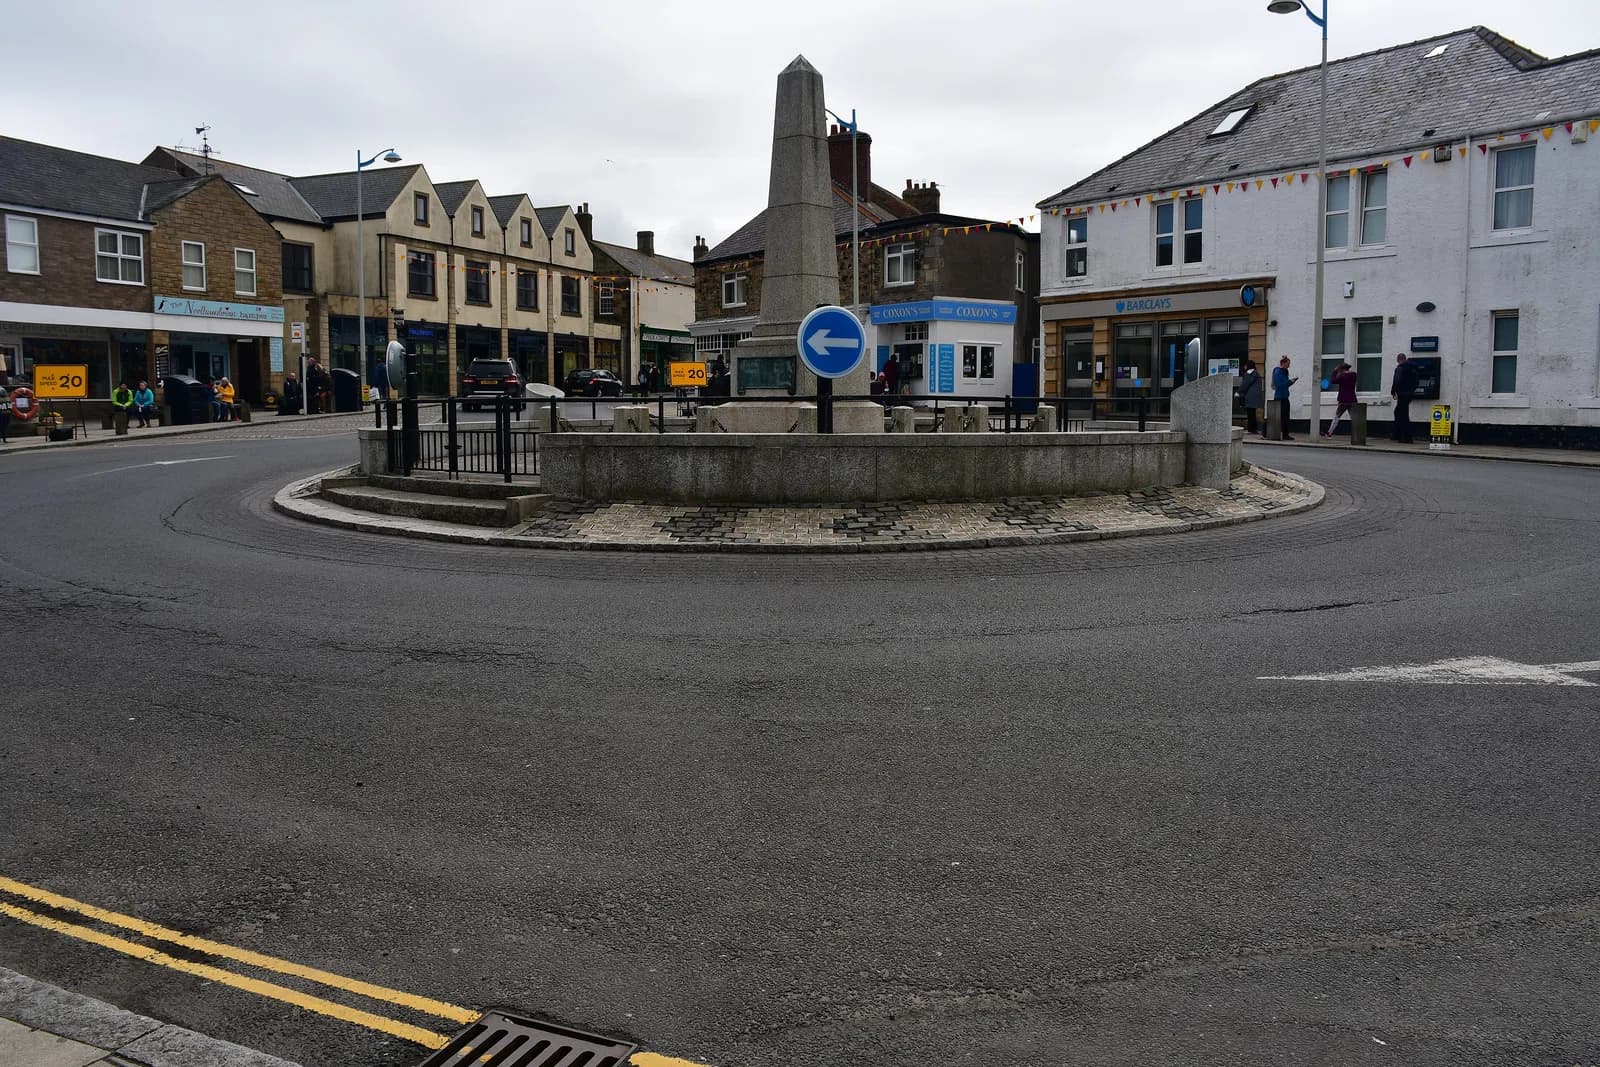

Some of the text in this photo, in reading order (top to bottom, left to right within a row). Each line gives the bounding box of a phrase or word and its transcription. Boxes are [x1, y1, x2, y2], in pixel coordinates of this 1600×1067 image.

[1127, 298, 1172, 311] BARCLAYS
[883, 306, 918, 318] COXON'S
[956, 306, 999, 319] COXON'S
[688, 369, 704, 379] 20
[59, 375, 83, 388] 20
